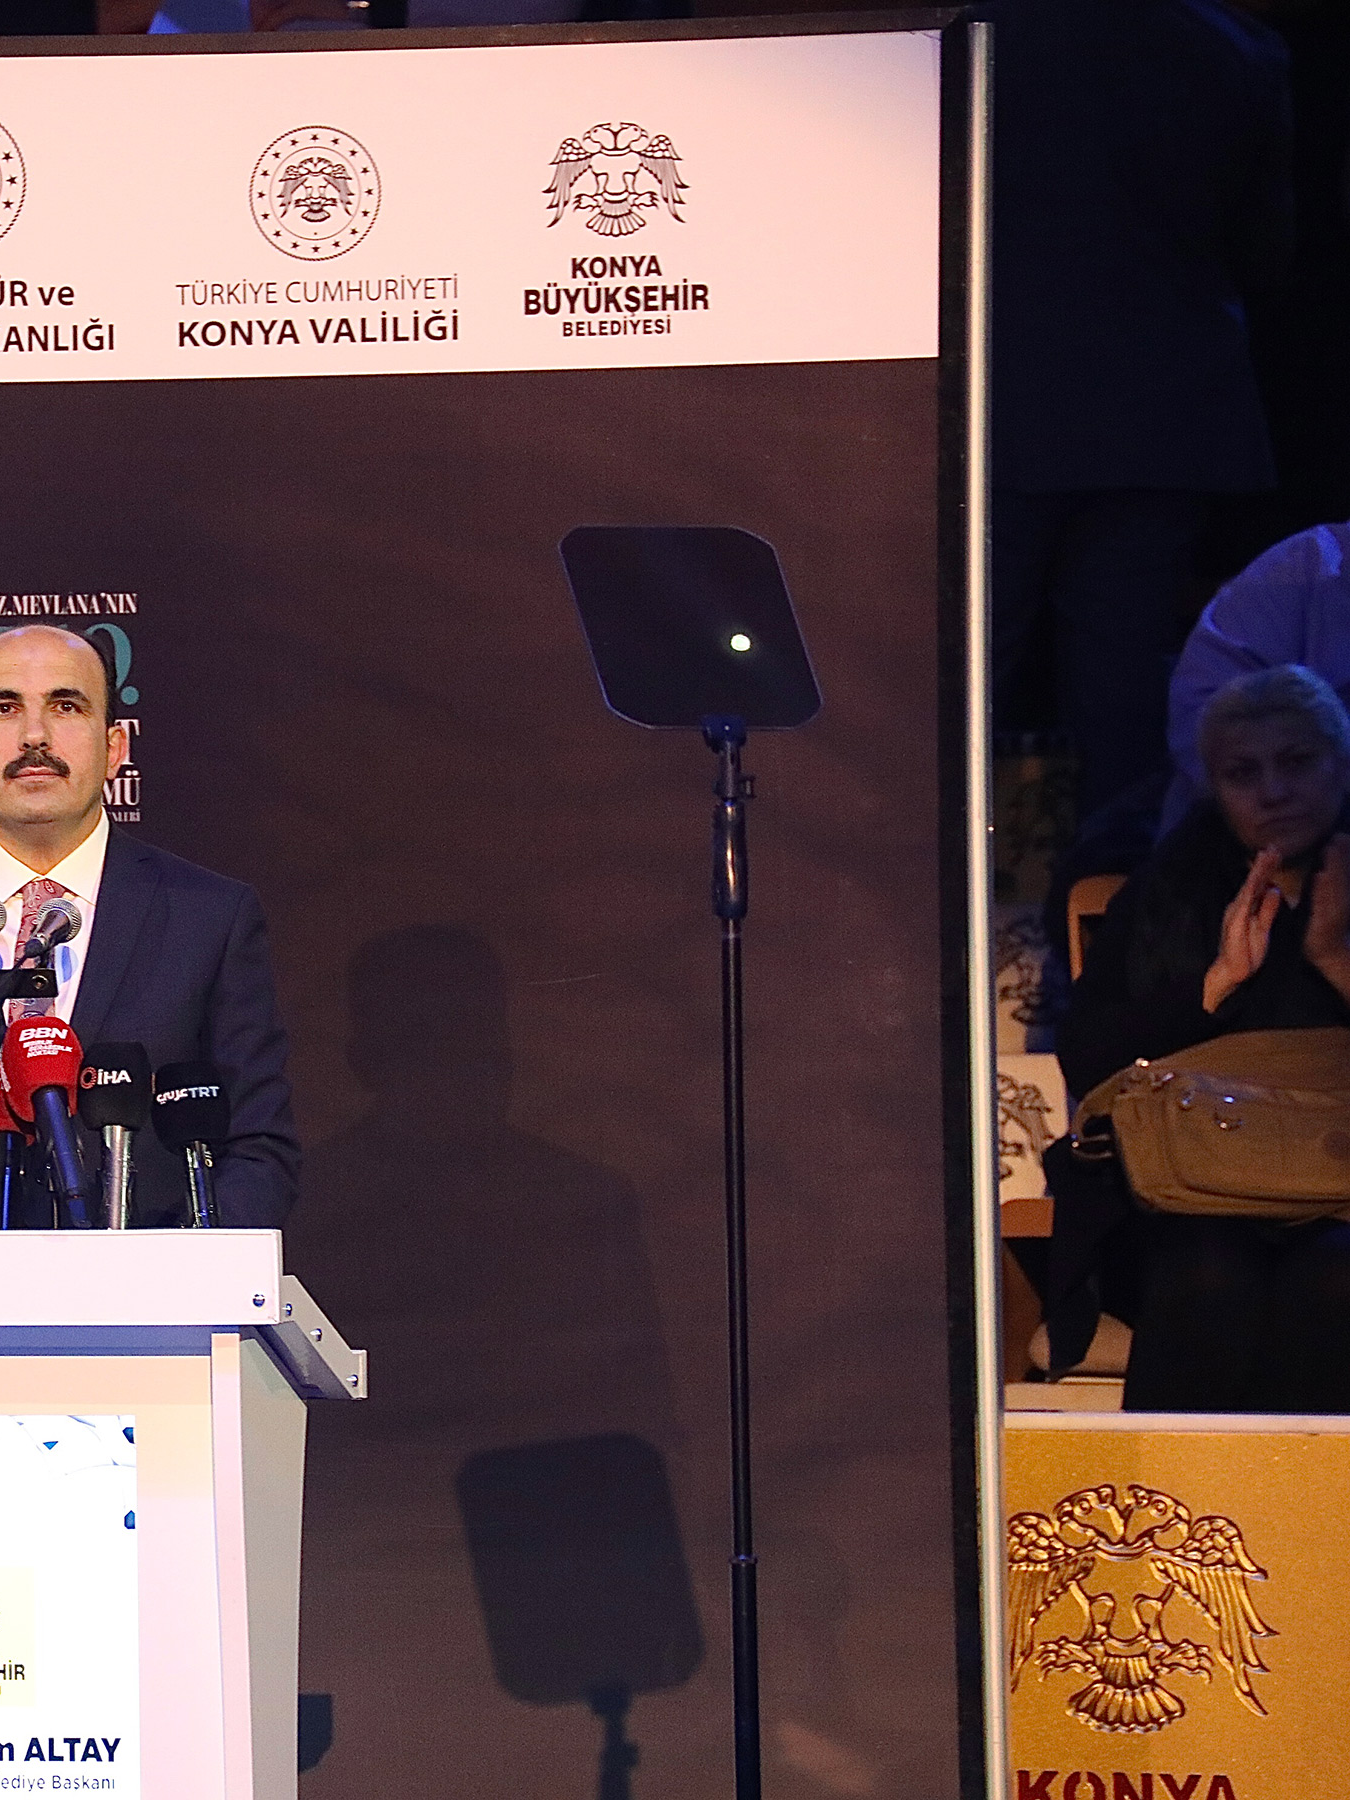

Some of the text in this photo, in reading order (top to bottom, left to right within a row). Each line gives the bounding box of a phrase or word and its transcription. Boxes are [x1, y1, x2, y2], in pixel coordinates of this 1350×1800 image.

[571, 255, 662, 279] KONYA
[38, 285, 75, 307] ve
[175, 272, 458, 306] TÜRKİYE CUMHURİYETİ
[524, 279, 710, 317] BÜYÜKŞEHİR
[178, 308, 459, 348] KONYA VALİLİĞİ
[562, 314, 672, 338] BELEDİYESİ
[18, 1027, 68, 1042] BBN
[97, 1068, 132, 1085] İHA
[188, 1086, 220, 1099] TRT
[24, 1737, 122, 1763] ALTAY
